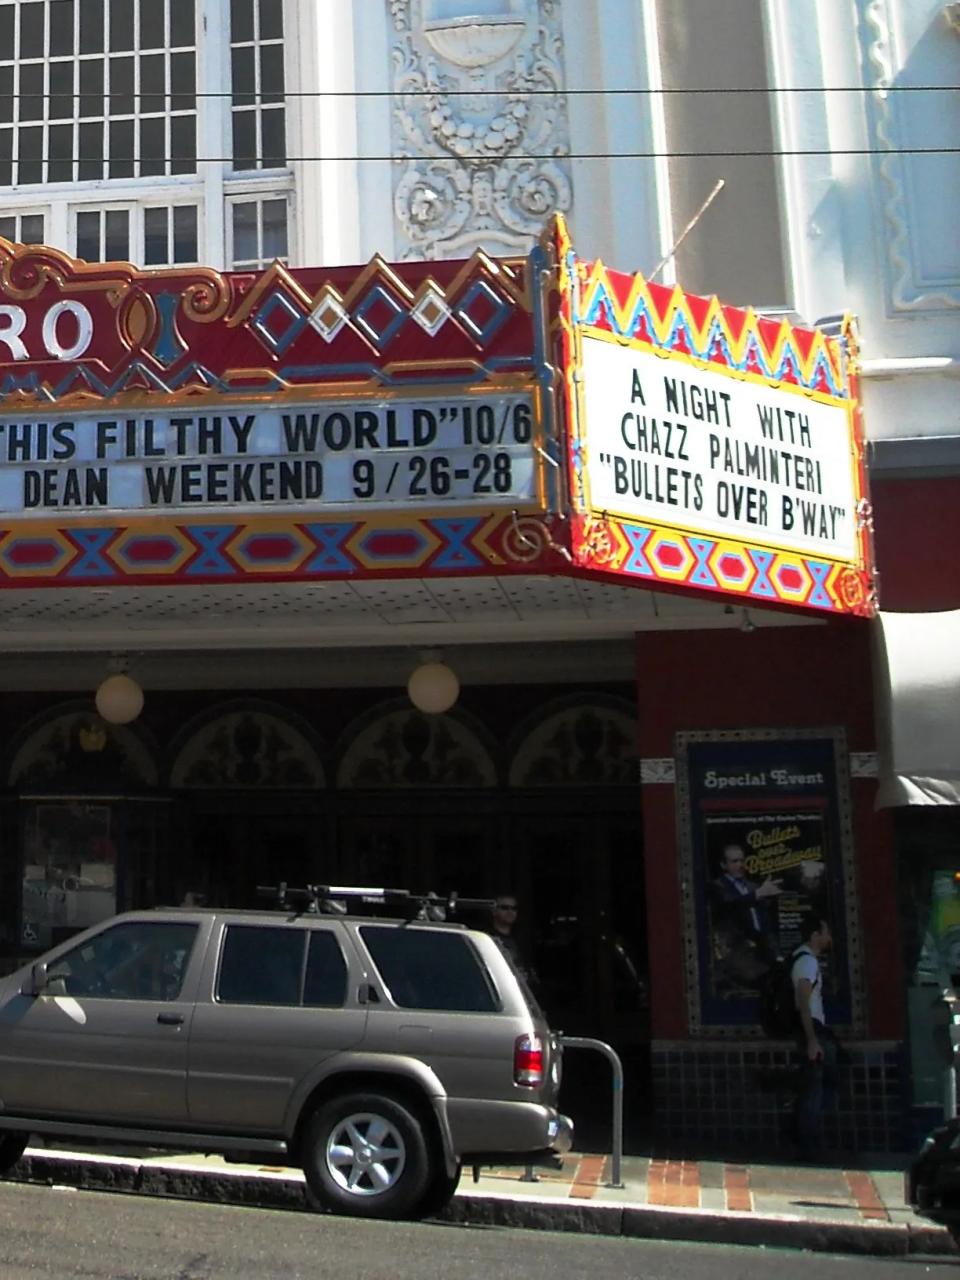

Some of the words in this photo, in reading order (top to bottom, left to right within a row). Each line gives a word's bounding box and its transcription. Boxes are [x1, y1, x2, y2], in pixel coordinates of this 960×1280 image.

[95, 415, 254, 459] FILTHY
[462, 403, 532, 446] 10/6
[630, 368, 646, 406] A
[663, 376, 732, 428] NIGHT
[756, 403, 812, 449] WITH
[23, 467, 109, 509] DEAN
[145, 459, 323, 504] WEEKEND
[352, 453, 513, 498] 9/26-28
[621, 412, 690, 461] CHAZZ
[709, 433, 823, 495] PALMINTERI
[716, 480, 769, 527] OVER
[704, 770, 767, 789] Special
[769, 768, 824, 786] Event
